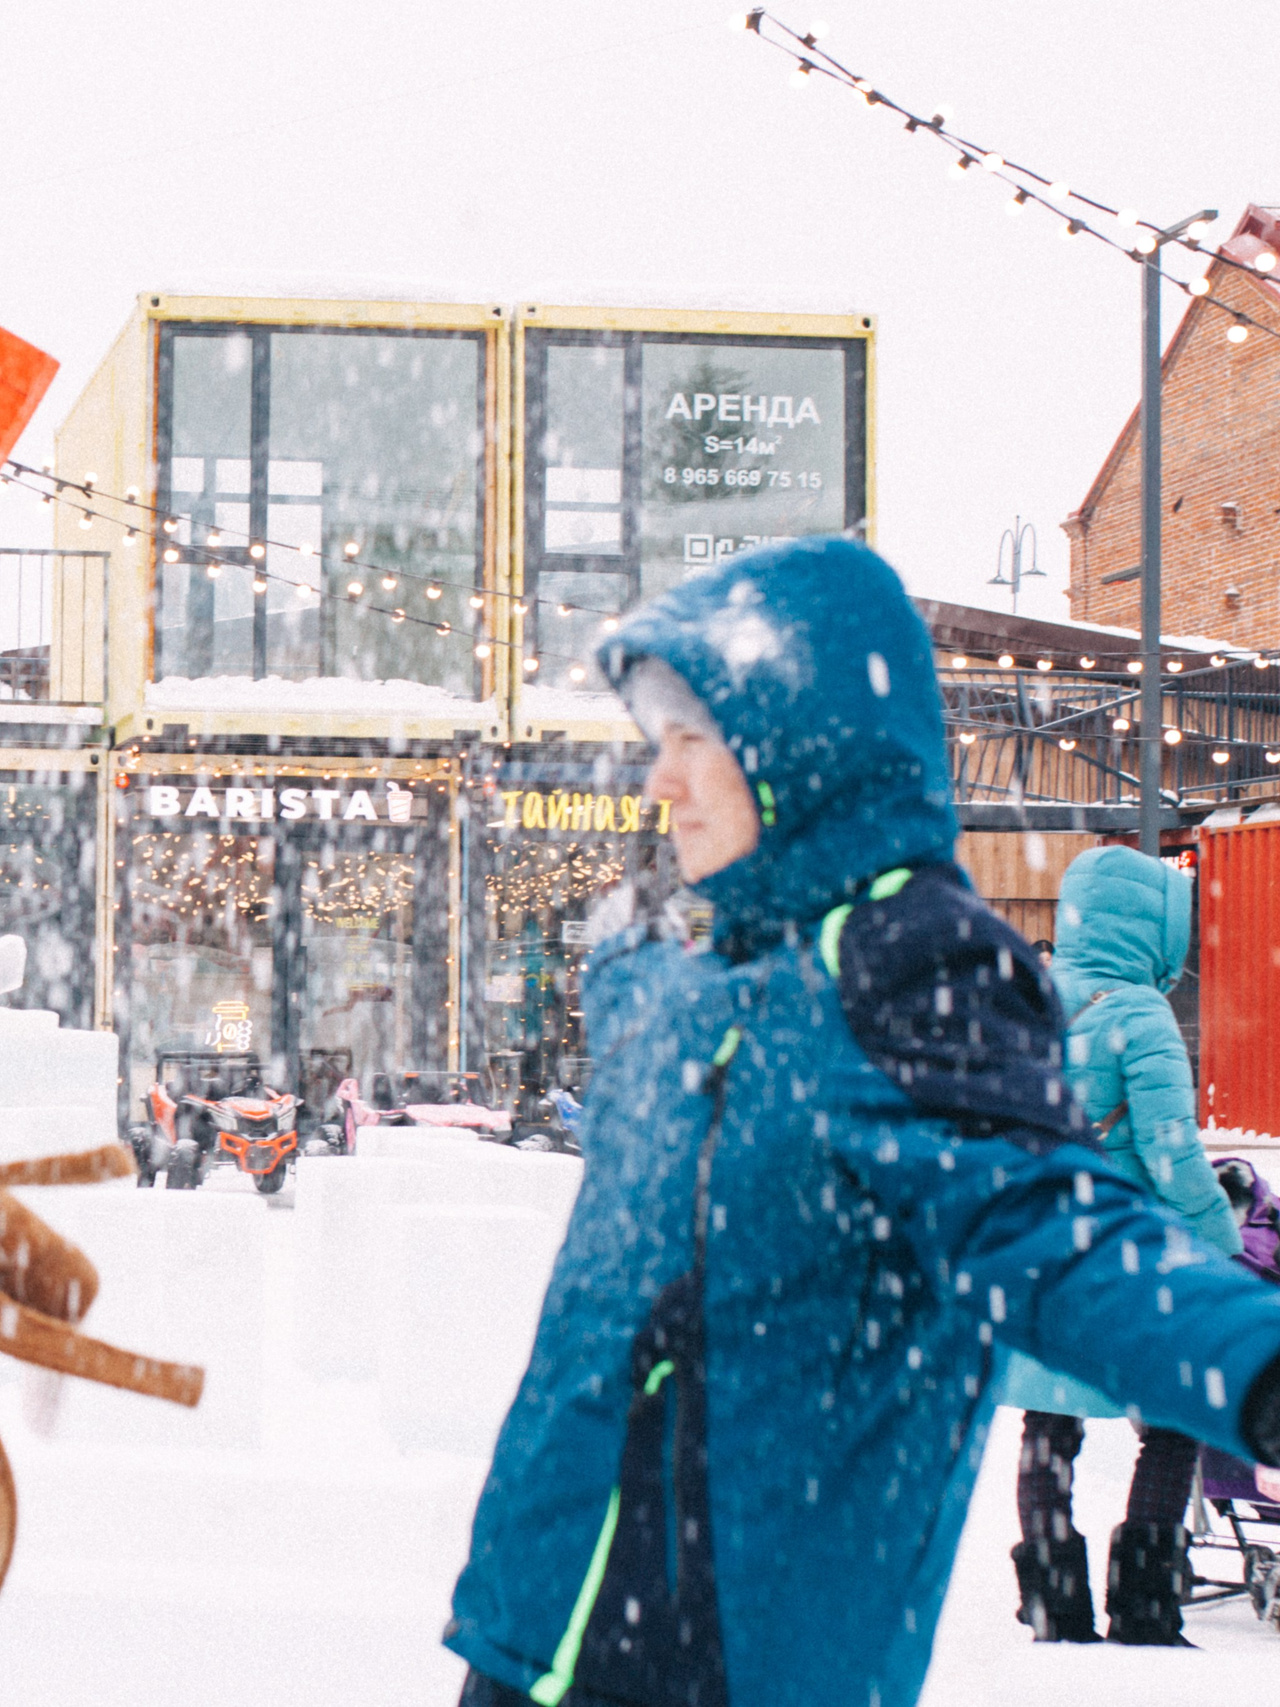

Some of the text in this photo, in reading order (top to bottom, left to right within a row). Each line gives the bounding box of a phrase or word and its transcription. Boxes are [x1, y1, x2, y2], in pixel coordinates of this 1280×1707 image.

[665, 392, 821, 429] АРЕНДА
[664, 467, 822, 489] 8 965 669 75 15
[149, 785, 379, 821] BARISTA
